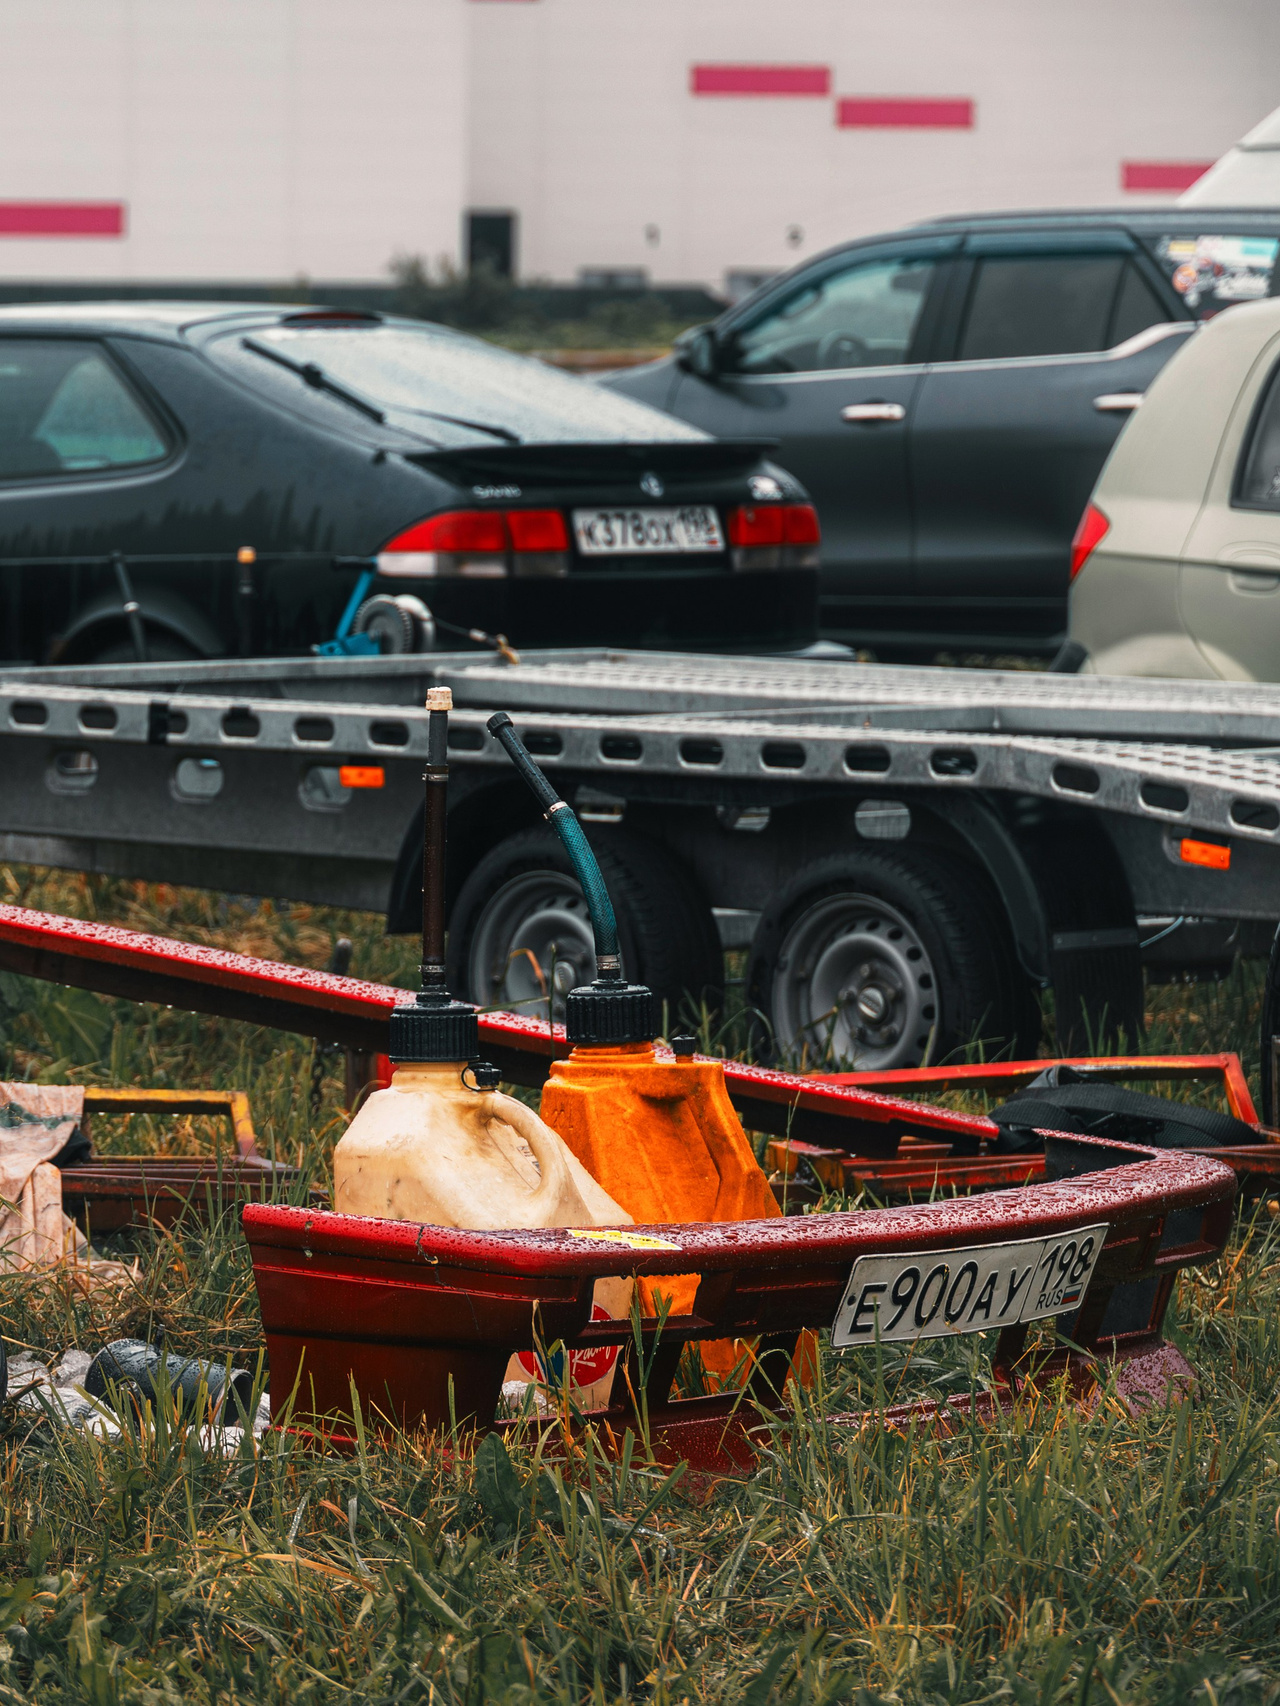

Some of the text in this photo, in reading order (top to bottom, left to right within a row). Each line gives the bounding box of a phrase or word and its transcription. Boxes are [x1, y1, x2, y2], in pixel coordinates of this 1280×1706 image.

[848, 1235, 1095, 1335] Е900АУ 198
[1035, 1289, 1063, 1311] RUS
